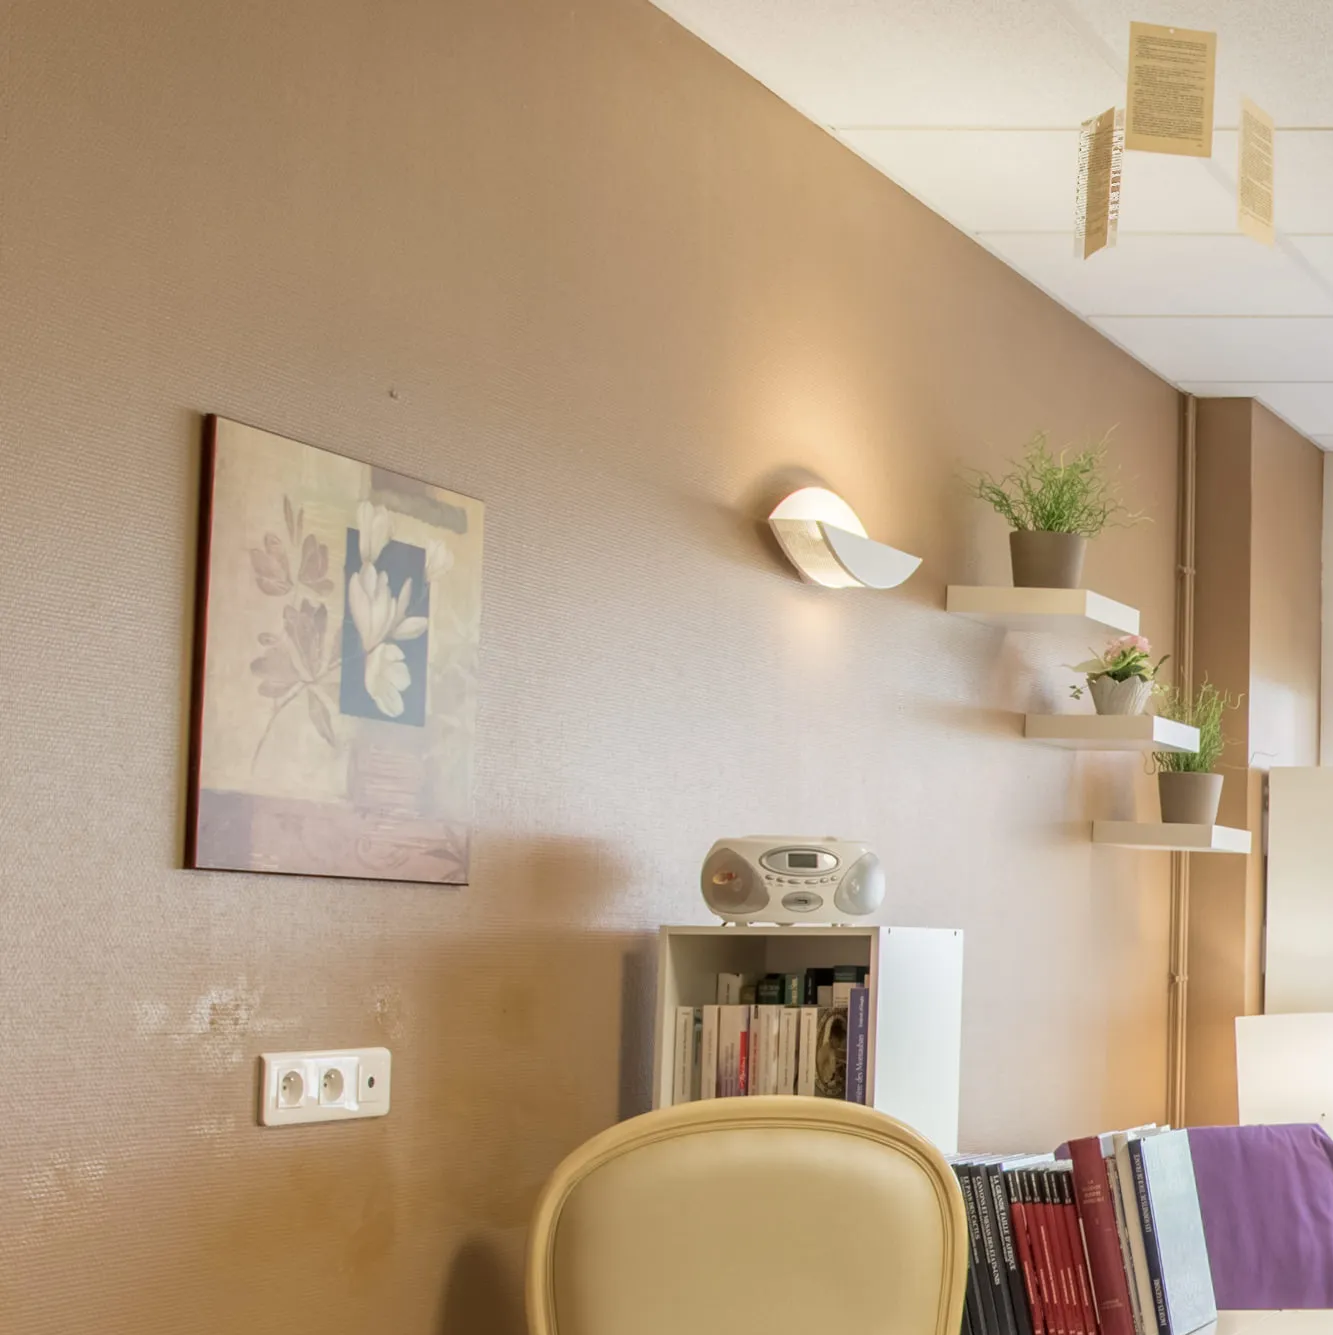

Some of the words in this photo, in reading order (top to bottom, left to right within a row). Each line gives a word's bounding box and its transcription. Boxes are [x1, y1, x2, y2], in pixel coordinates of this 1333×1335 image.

[992, 1175, 1000, 1184] LA
[962, 1176, 970, 1184] LE
[970, 1214, 981, 1240] CACTUS
[975, 1176, 985, 1205] CANYONS
[981, 1205, 988, 1215] ET
[994, 1185, 1004, 1212] GRANDE
[999, 1212, 1010, 1235] FAILLE
[1003, 1236, 1016, 1271] D'AFRIQUE
